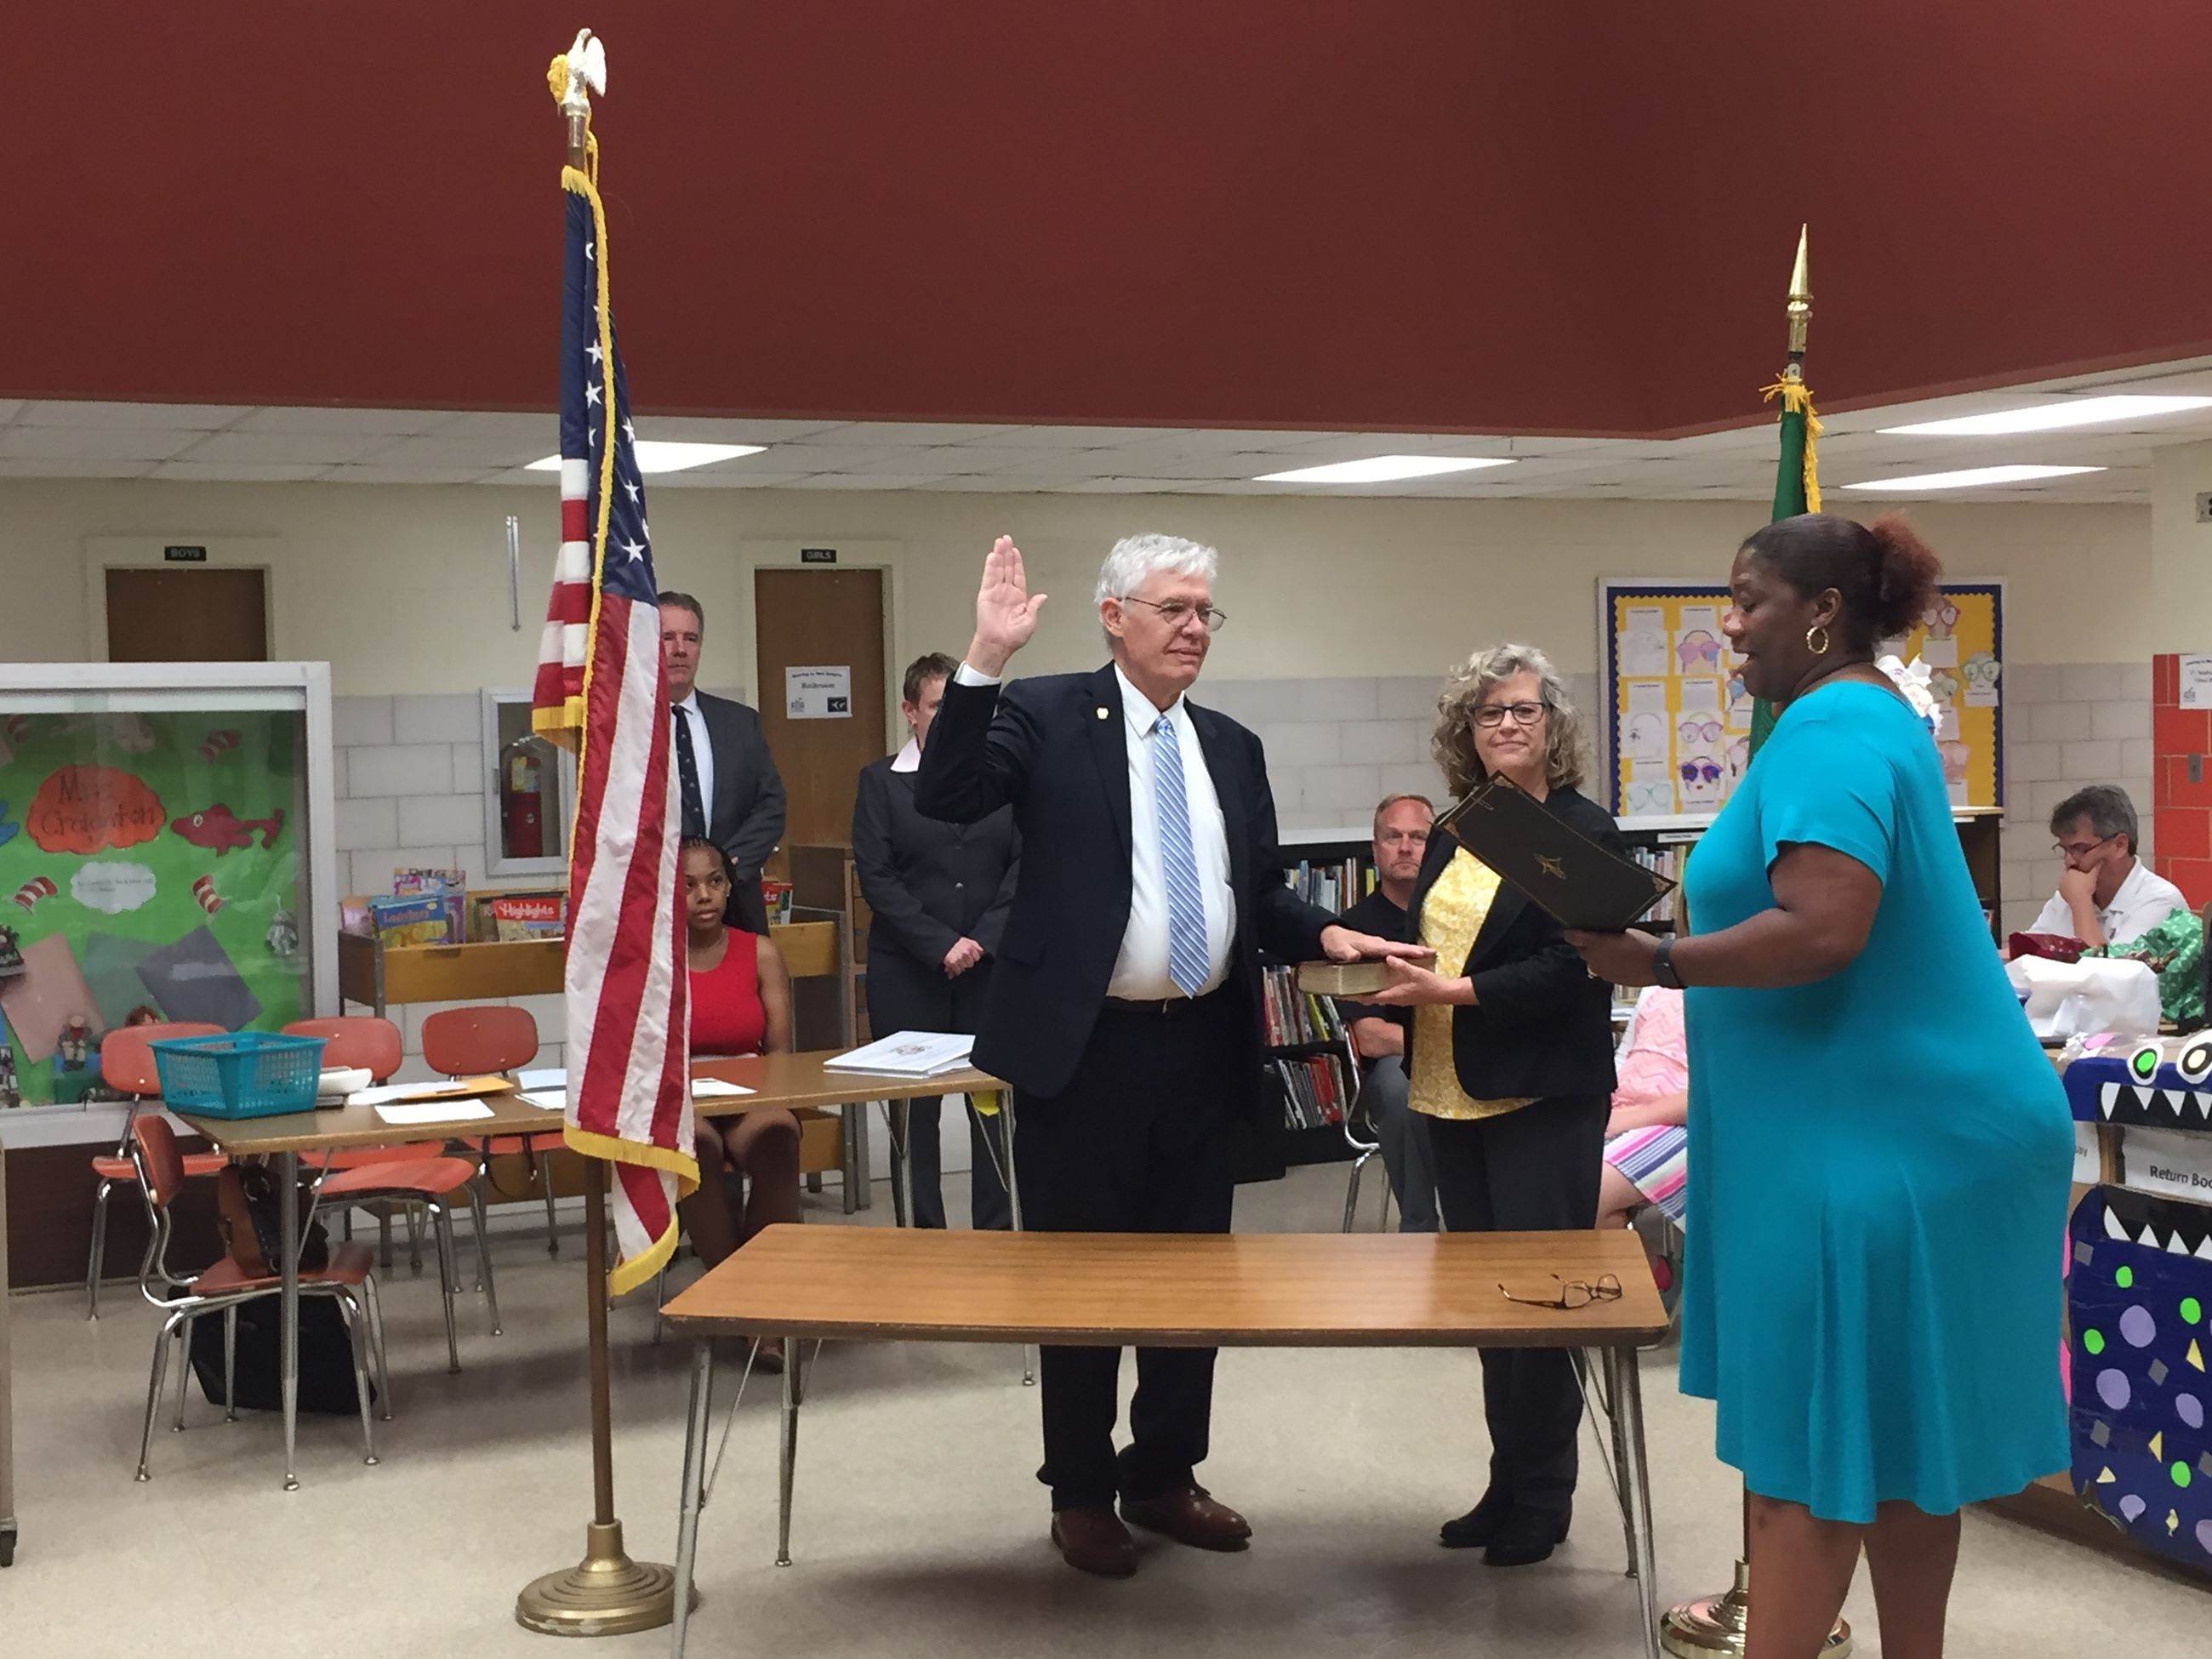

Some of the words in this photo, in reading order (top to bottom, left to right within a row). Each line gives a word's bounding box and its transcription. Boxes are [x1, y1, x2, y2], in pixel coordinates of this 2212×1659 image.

[170, 548, 200, 558] BOYS
[806, 550, 831, 559] GIRLS
[499, 902, 556, 920] Highlights
[2149, 1165, 2189, 1184] Return
